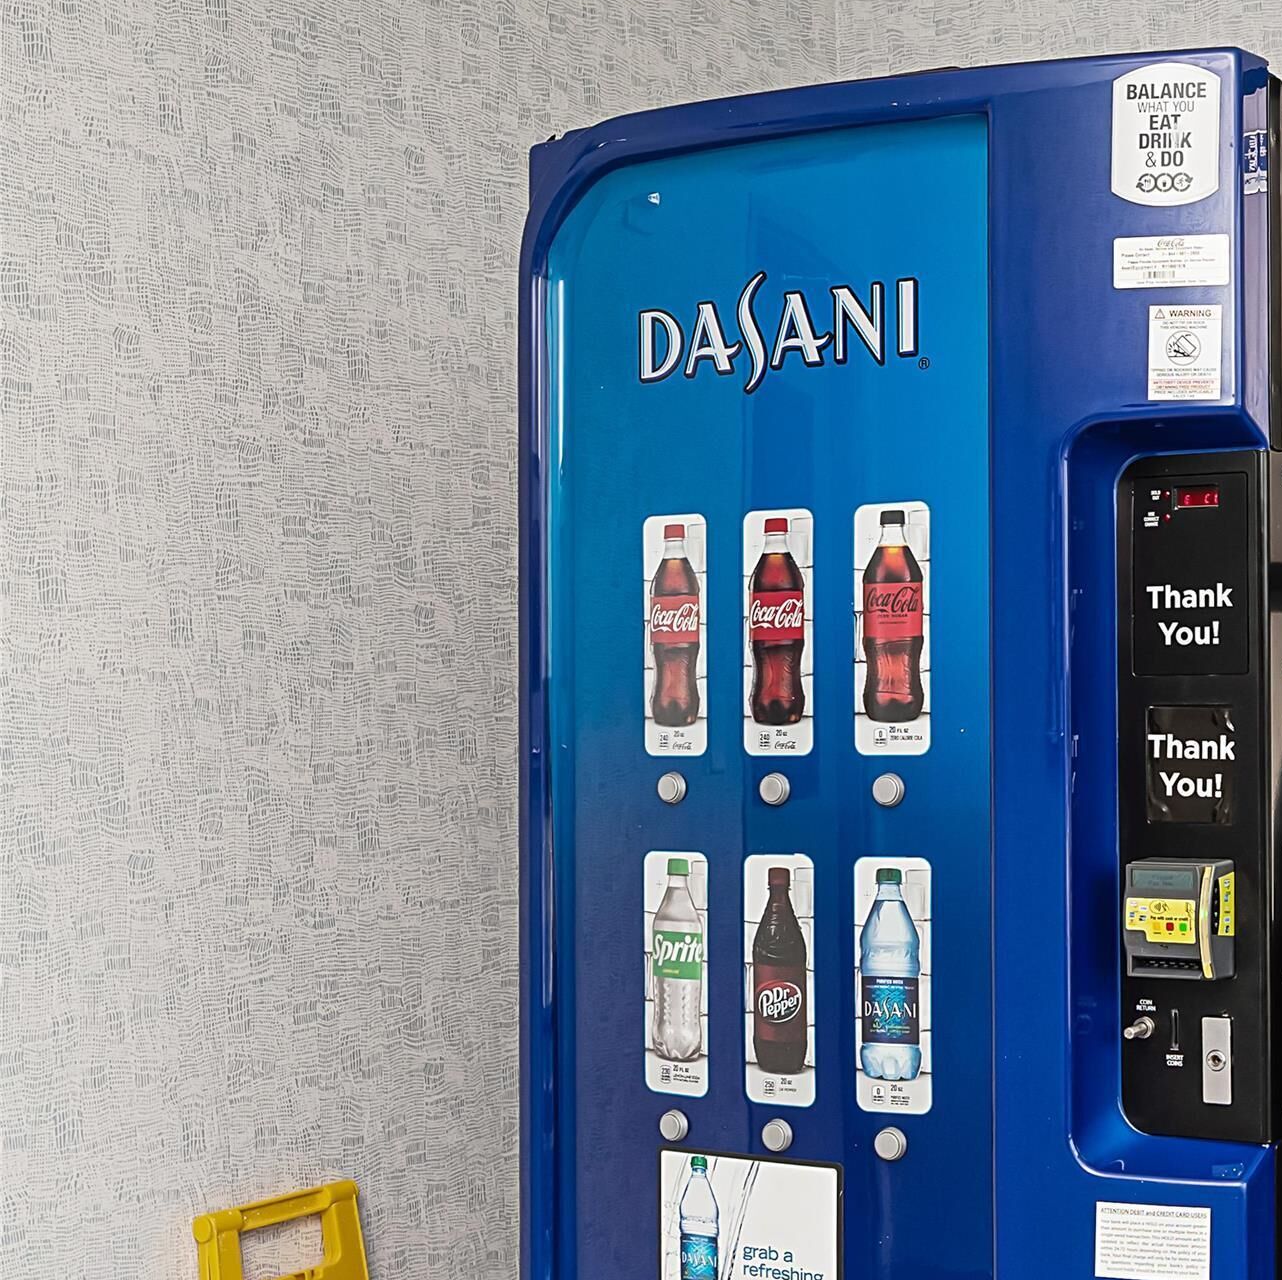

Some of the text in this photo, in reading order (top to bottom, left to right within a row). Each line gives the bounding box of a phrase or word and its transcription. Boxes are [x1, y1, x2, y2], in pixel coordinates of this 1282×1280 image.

[1126, 82, 1206, 100] BALANCE
[1137, 101, 1195, 113] WHAT YOU
[1150, 114, 1181, 130] EAT
[1145, 150, 1184, 167] & DO
[1169, 309, 1212, 317] WARNING
[639, 271, 920, 395] DASANI
[866, 586, 920, 613] Coca-Cola
[1146, 583, 1233, 610] Thank
[651, 603, 699, 632] Coca-Cola
[751, 598, 804, 629] Coca-Cola
[1158, 621, 1220, 645] You!
[1148, 734, 1236, 761] Thank
[1160, 772, 1222, 799] You!
[653, 934, 703, 966] Sprite
[760, 990, 800, 1018] Pepper
[772, 987, 790, 1003] Dr
[864, 999, 916, 1020] DASANI
[1100, 1207, 1129, 1215] ATTENTION
[743, 1246, 793, 1263] grab a
